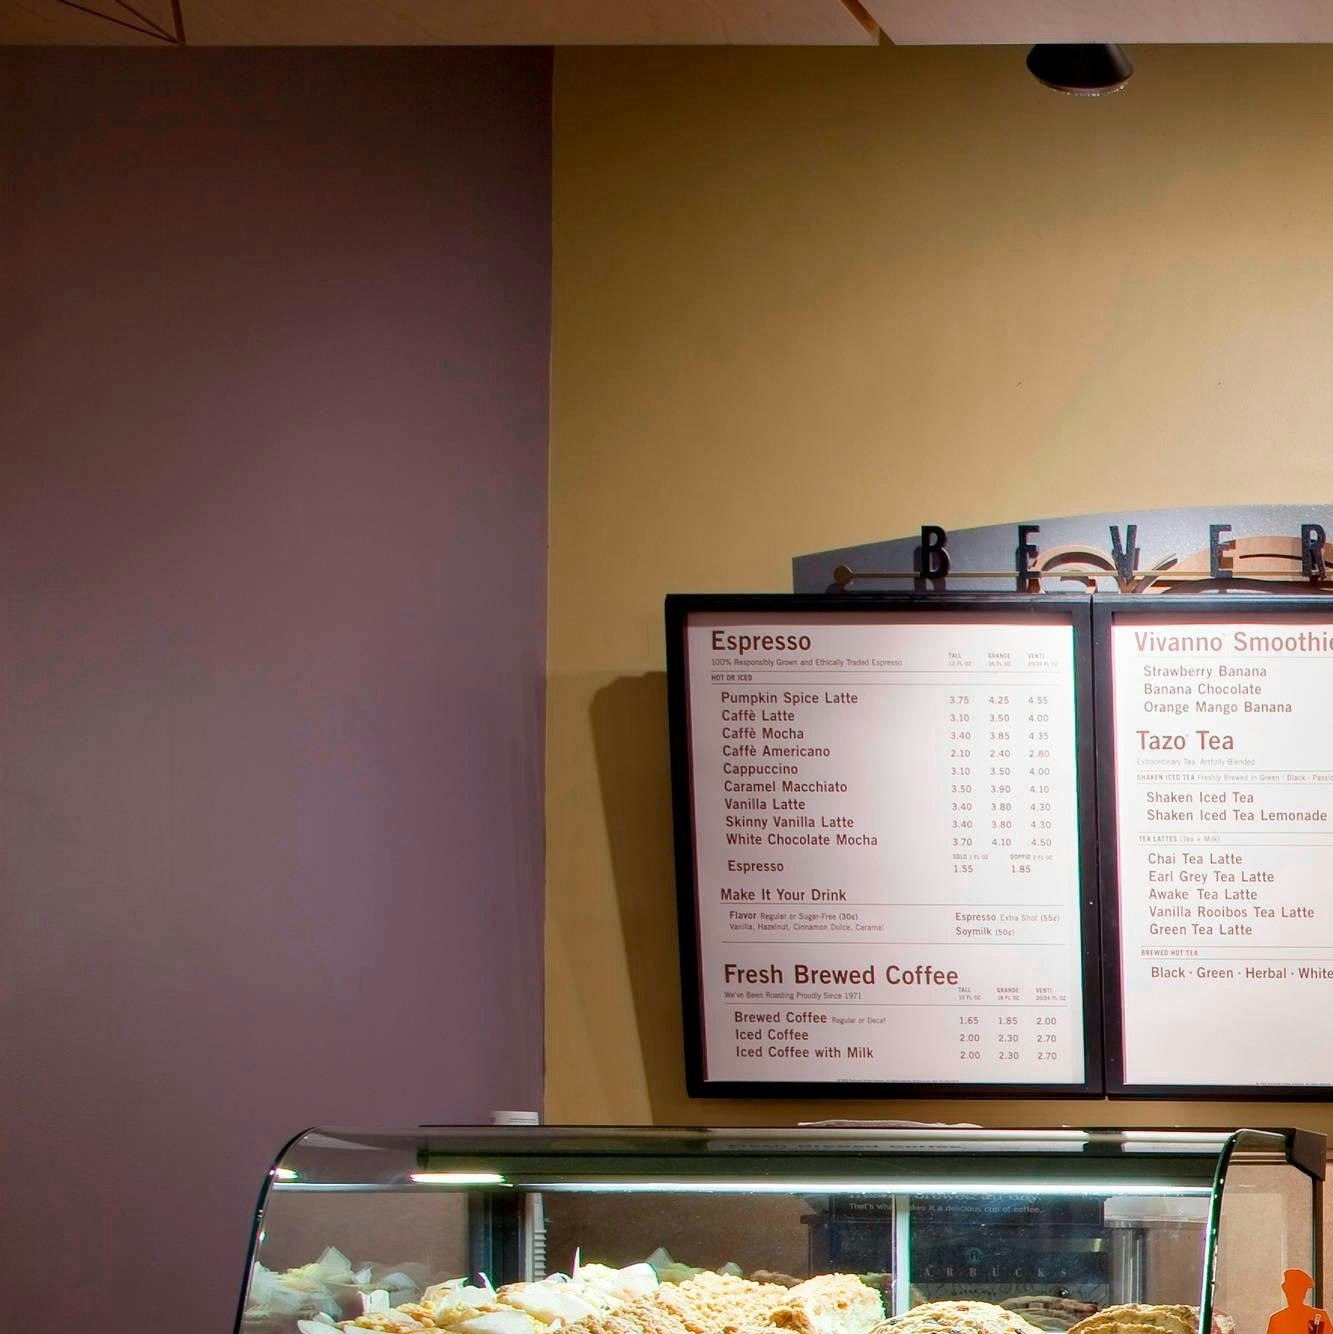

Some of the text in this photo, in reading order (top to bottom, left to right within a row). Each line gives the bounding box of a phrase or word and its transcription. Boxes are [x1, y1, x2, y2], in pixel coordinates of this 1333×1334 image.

[711, 631, 812, 655] Espresso
[1144, 664, 1213, 678] Strawberry
[1219, 665, 1266, 678] Banana
[721, 691, 1048, 706] Pumpkin Spice Latte 3.75 4.25 4.55
[1197, 731, 1233, 751] Tea
[724, 780, 847, 793] Caramel Macchiato
[727, 834, 878, 846] White Chocolate Mocha
[721, 889, 846, 901] Make It Your Drink
[1149, 906, 1314, 919] Vanilla Rooibos Tea Latte
[725, 964, 958, 986] Fresh Brewed Coffee
[736, 1046, 873, 1058] Iced Coffee with Milk
